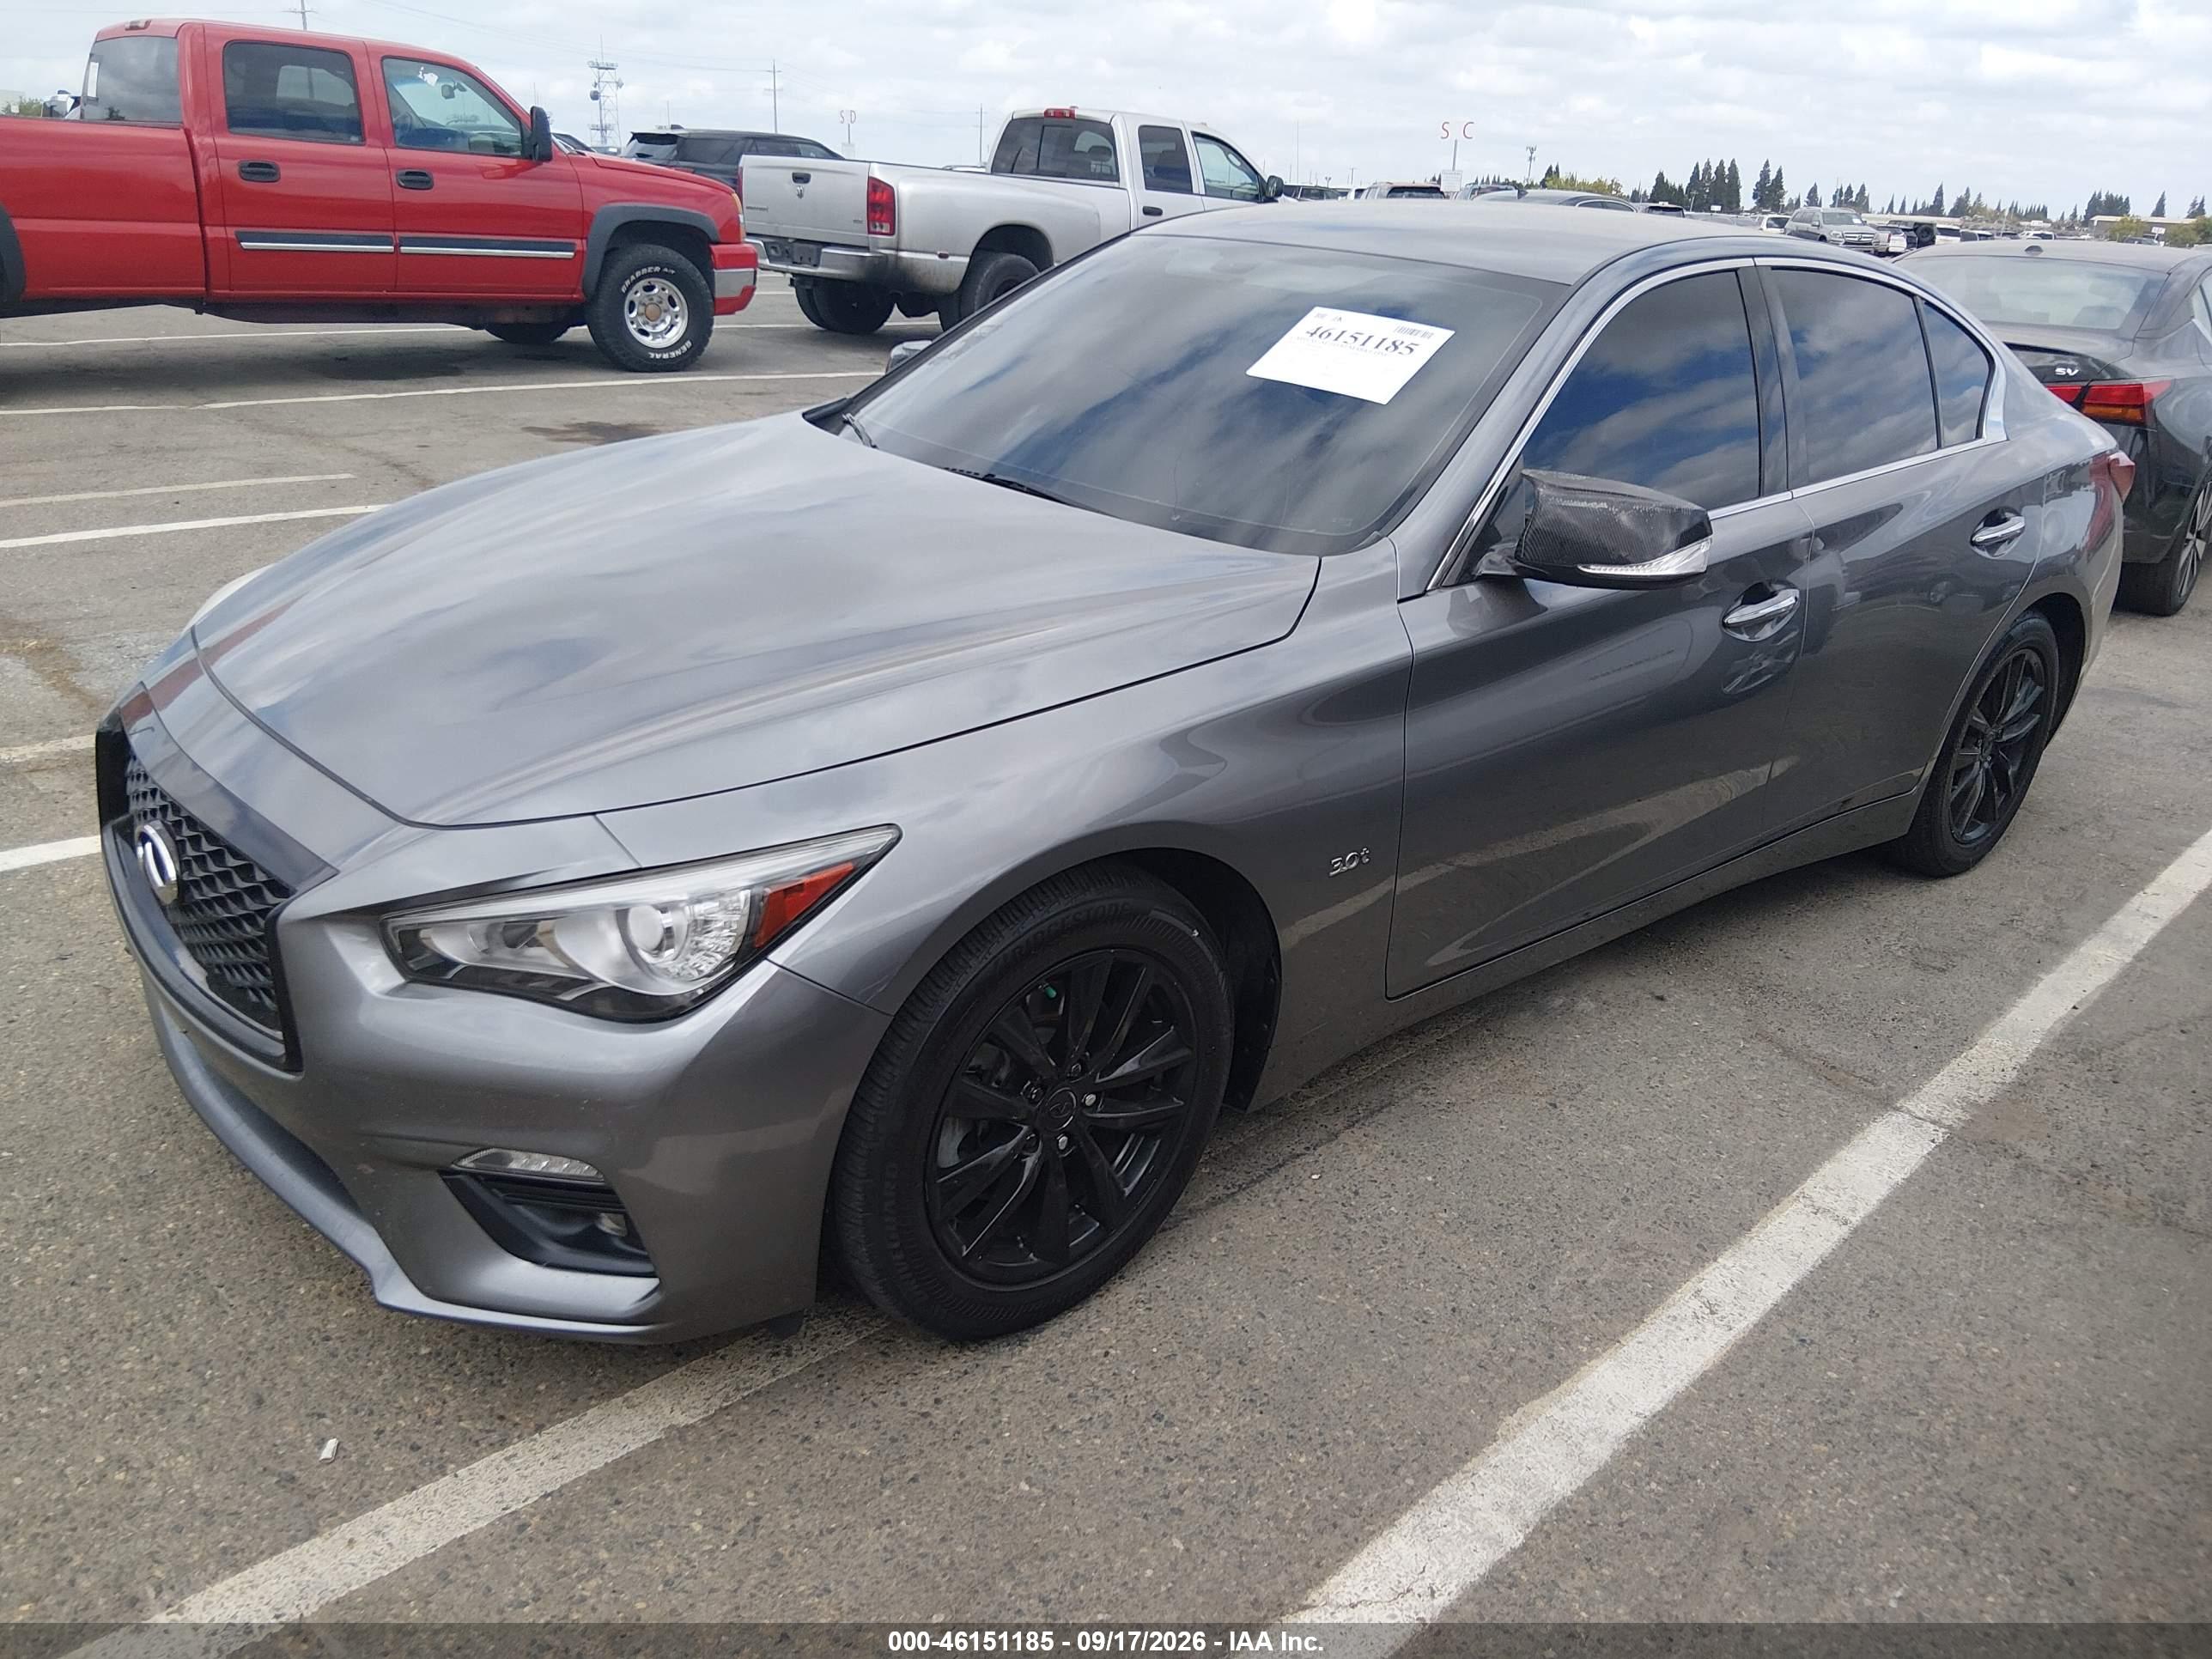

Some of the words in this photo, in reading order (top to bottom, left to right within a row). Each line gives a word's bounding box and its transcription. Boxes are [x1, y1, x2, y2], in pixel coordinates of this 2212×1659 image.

[840, 109, 845, 124] S
[850, 109, 857, 124] D
[1440, 121, 1449, 139] S
[1462, 121, 1474, 139] C
[648, 340, 692, 359] GENERAL
[1305, 325, 1420, 356] 46151185
[2055, 368, 2079, 376] SV
